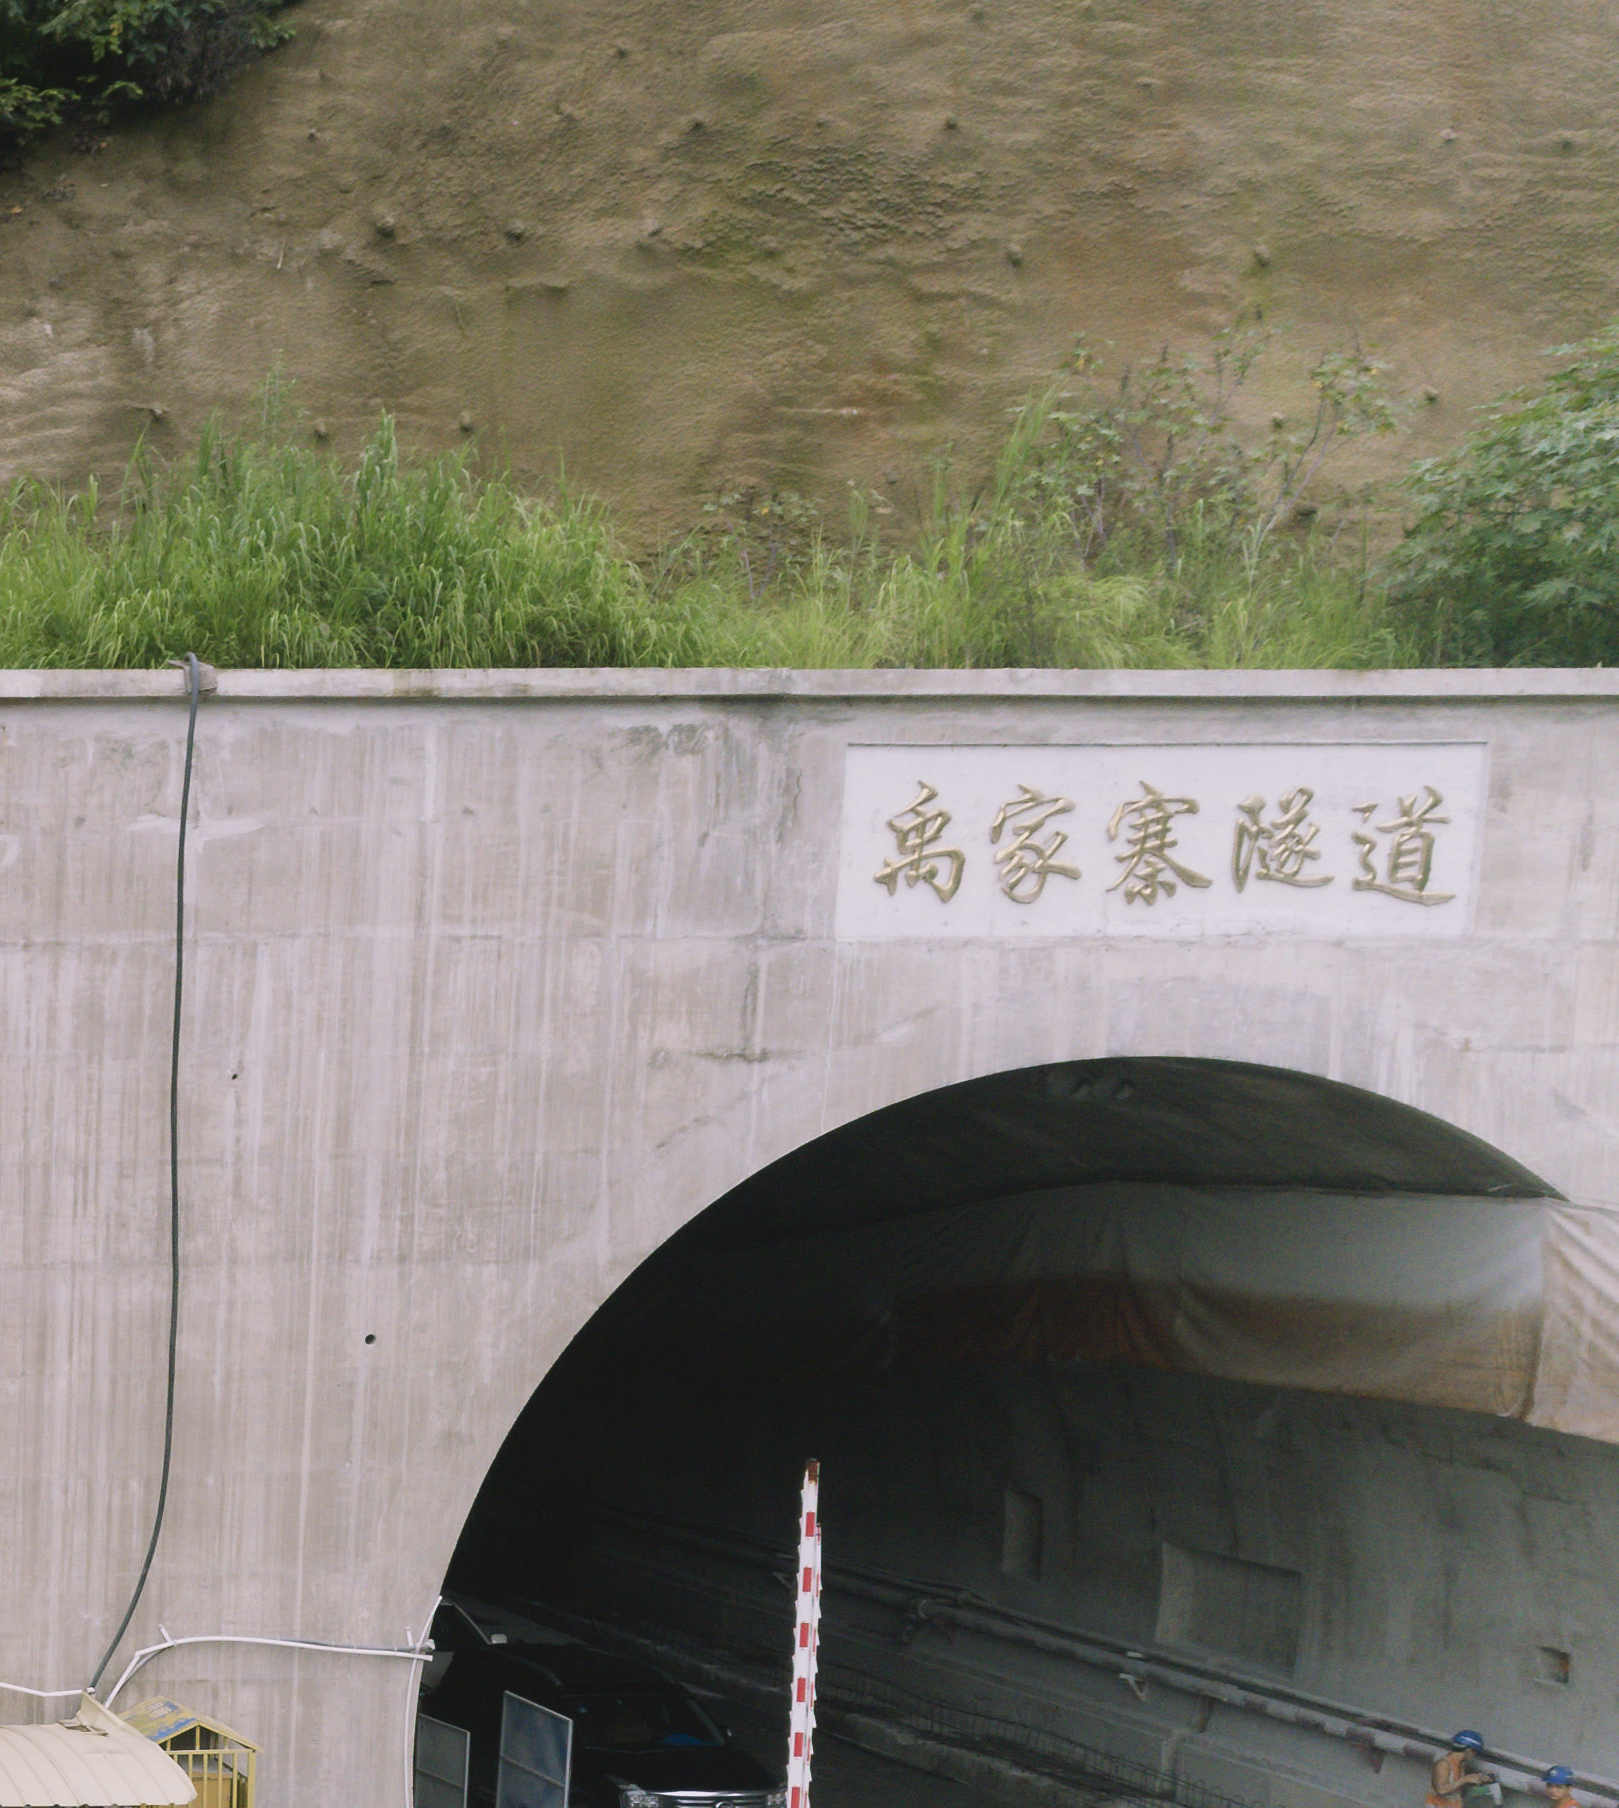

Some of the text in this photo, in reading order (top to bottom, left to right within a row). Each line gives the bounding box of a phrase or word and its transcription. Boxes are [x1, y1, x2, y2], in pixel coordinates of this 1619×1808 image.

[874, 780, 1456, 906] 禹家寨隧道
